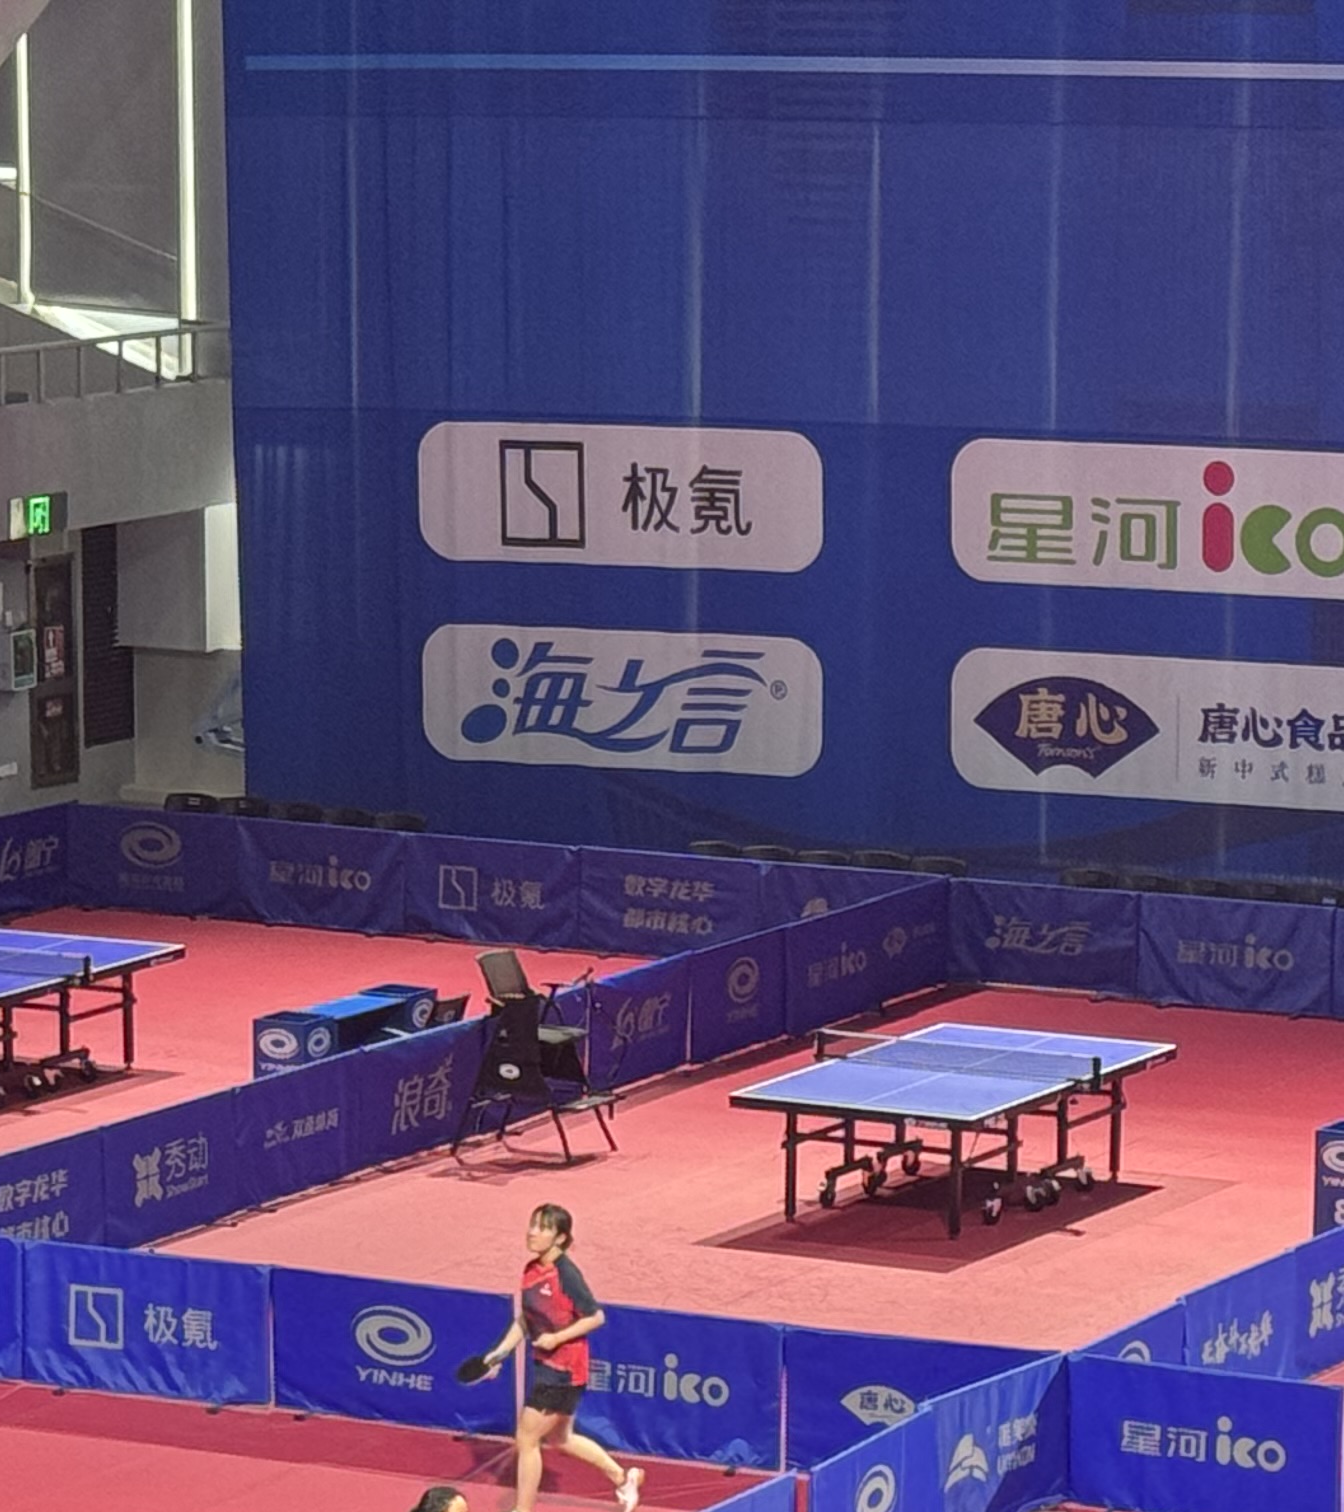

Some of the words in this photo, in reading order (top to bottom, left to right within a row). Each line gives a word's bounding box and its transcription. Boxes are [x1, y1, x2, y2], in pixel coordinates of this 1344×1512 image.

[621, 462, 753, 537] 极氪
[460, 638, 768, 755] 海之言
[1014, 687, 1130, 746] 唐心
[391, 1066, 456, 1136] 浪奇
[164, 1132, 210, 1182] 秀动
[143, 1302, 220, 1352] 极氪
[355, 1364, 435, 1392] YINHE
[1119, 1415, 1287, 1473] 星河ico
